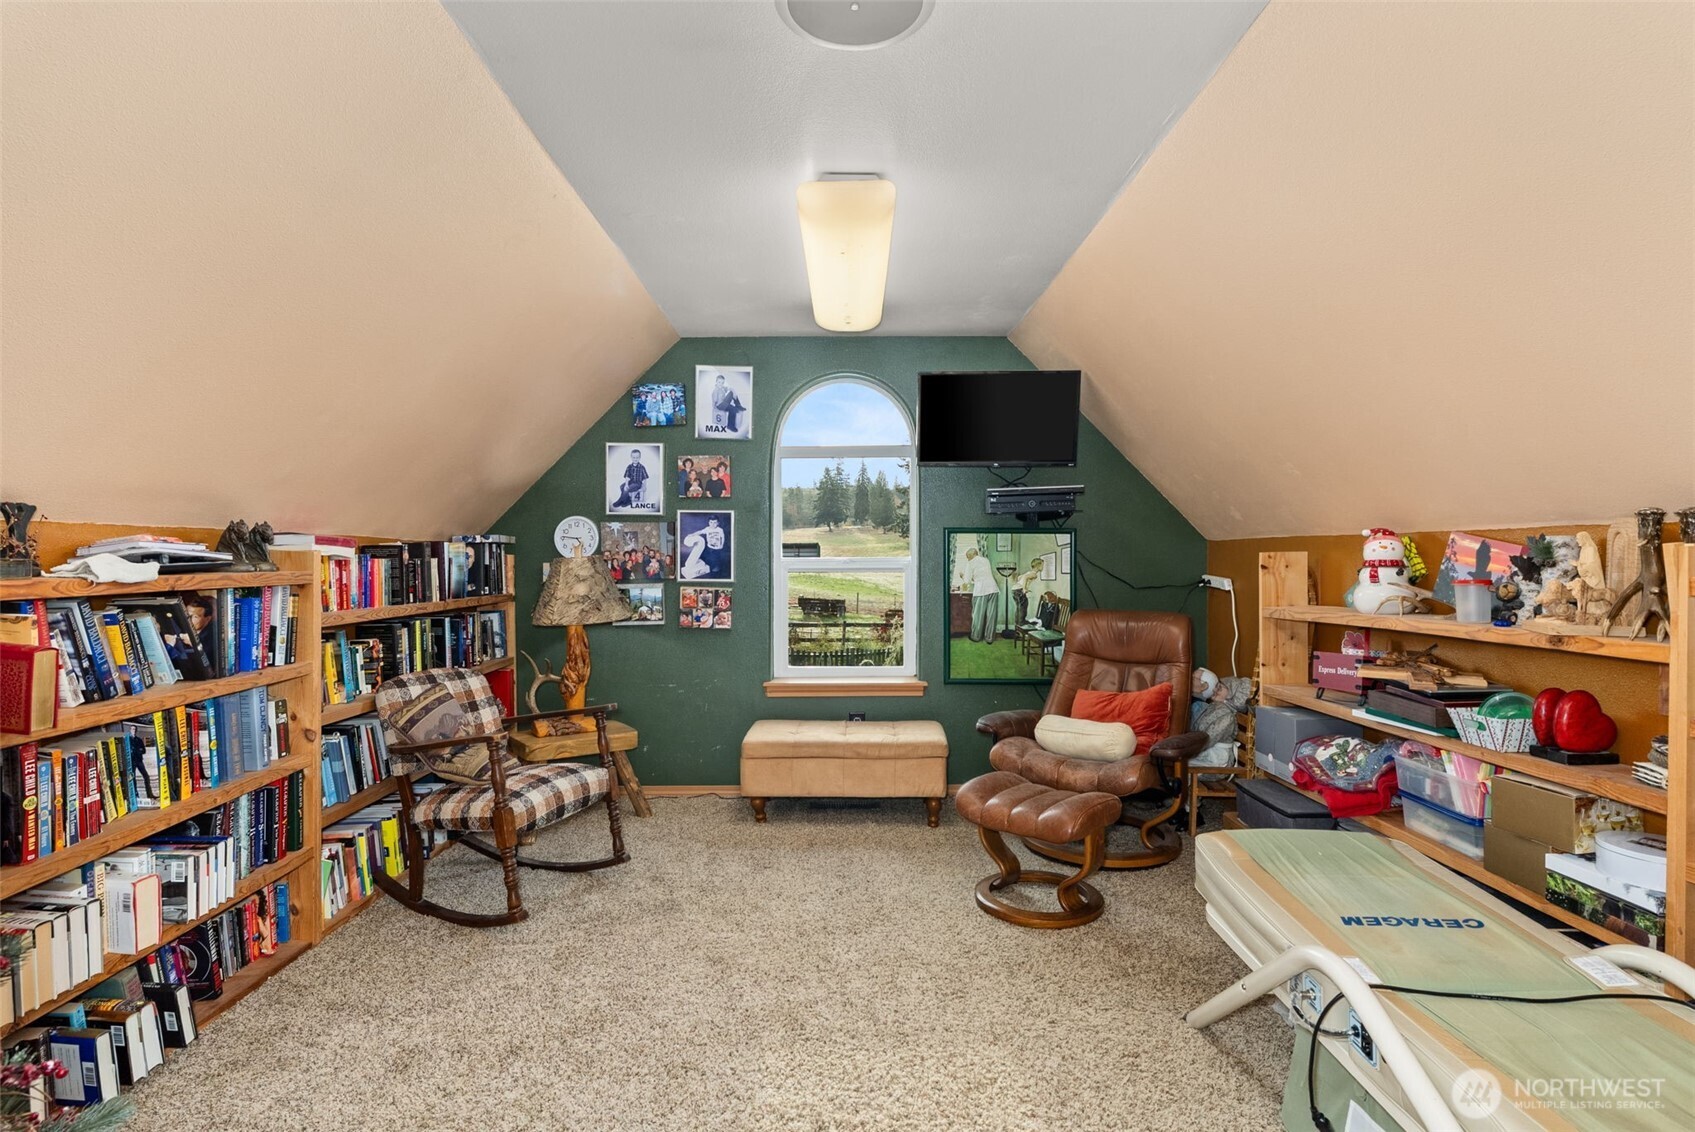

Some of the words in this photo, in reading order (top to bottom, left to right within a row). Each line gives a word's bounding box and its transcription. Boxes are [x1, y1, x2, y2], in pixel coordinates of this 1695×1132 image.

[705, 424, 727, 433] MAX
[264, 588, 272, 611] DAVID
[281, 587, 290, 606] DAVID
[263, 611, 271, 646] BALDACCI
[280, 606, 288, 636] BALDACCI
[81, 602, 95, 627] DAVID
[88, 627, 106, 664] BALDACCI
[120, 621, 131, 642] DAVID
[125, 642, 139, 676] BALDACCI
[1318, 665, 1336, 675] Express
[1337, 667, 1357, 677] Delivery
[258, 690, 266, 704] TOM
[259, 705, 267, 733] CLANCY
[25, 760, 35, 773] LEE
[88, 767, 97, 778] LEE
[25, 774, 35, 796] CHILD
[89, 778, 97, 795] CHILD
[1340, 916, 1485, 929] CERAGEM
